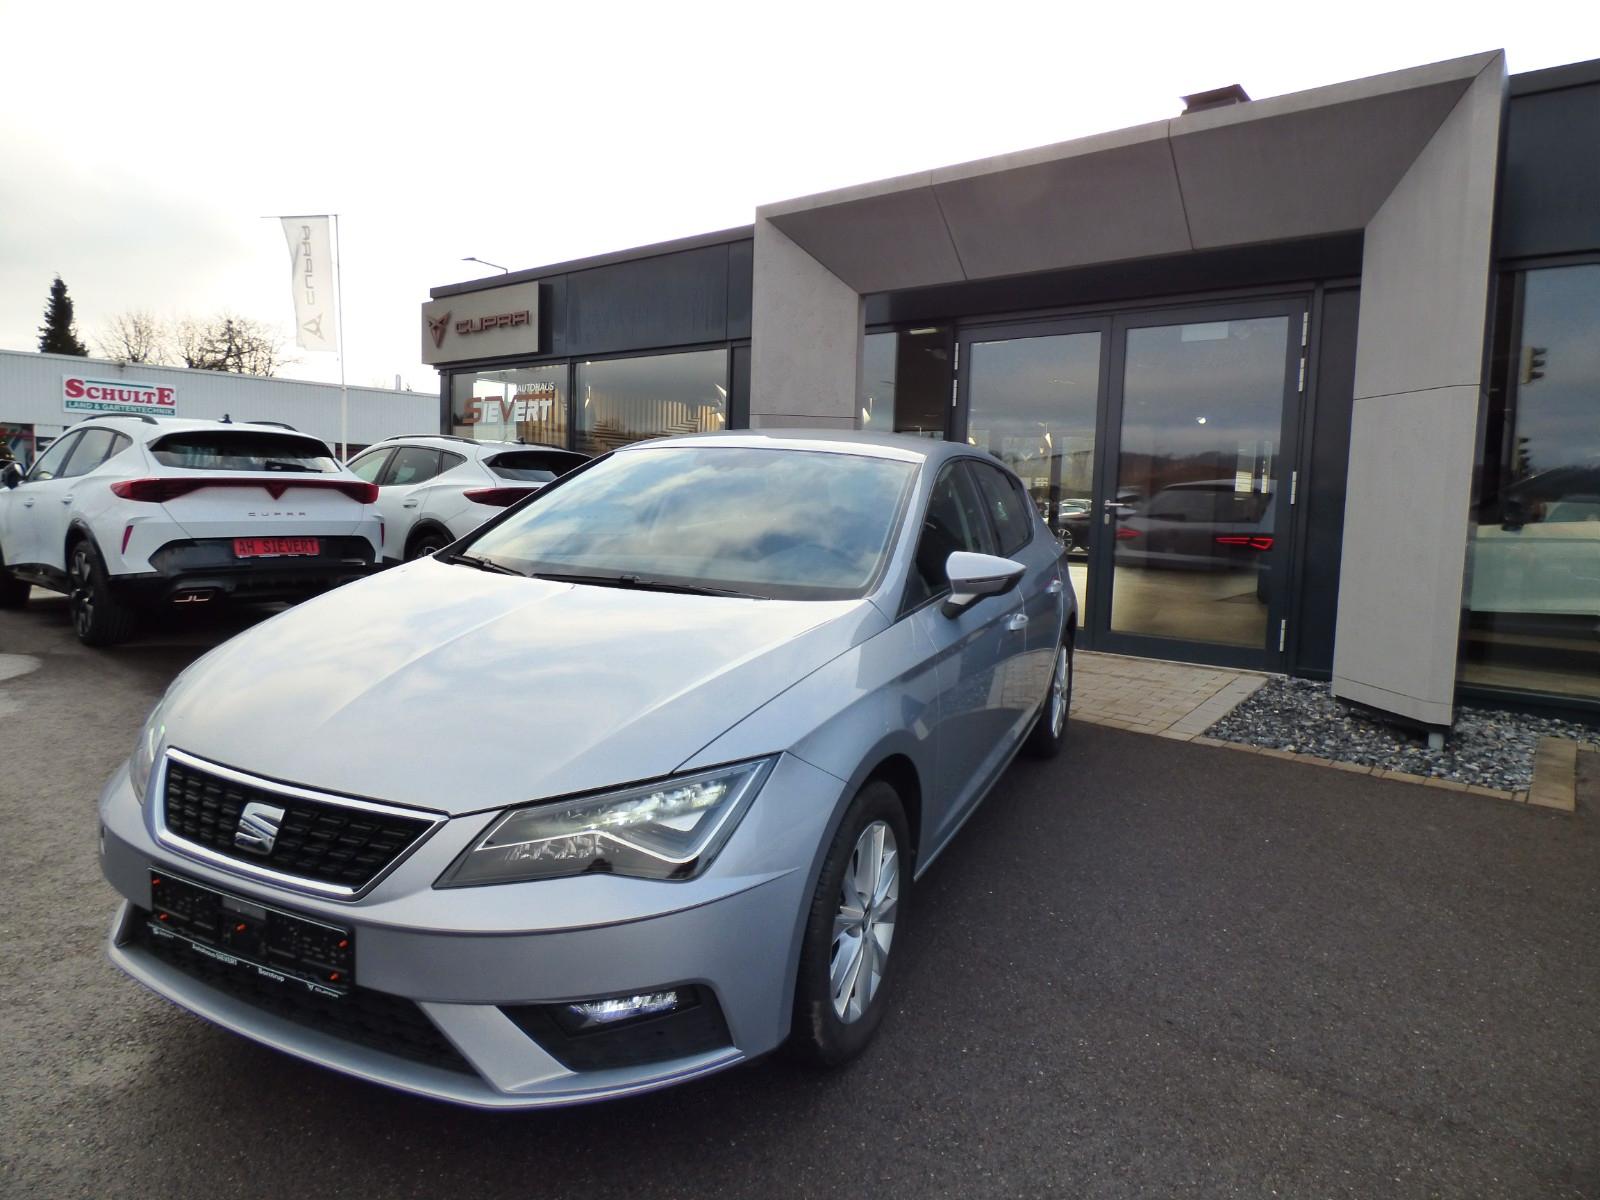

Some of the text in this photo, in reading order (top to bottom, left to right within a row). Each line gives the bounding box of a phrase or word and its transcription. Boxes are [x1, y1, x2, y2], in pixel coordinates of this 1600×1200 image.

[456, 310, 530, 336] CUPRA
[65, 378, 176, 406] SCHULTE
[516, 382, 555, 393] AUTOHAUS
[68, 401, 93, 410] LAND
[102, 403, 174, 415] GARTENTECHNIK
[462, 391, 555, 425] SIEVERT
[239, 539, 317, 554] AH SIEVERT
